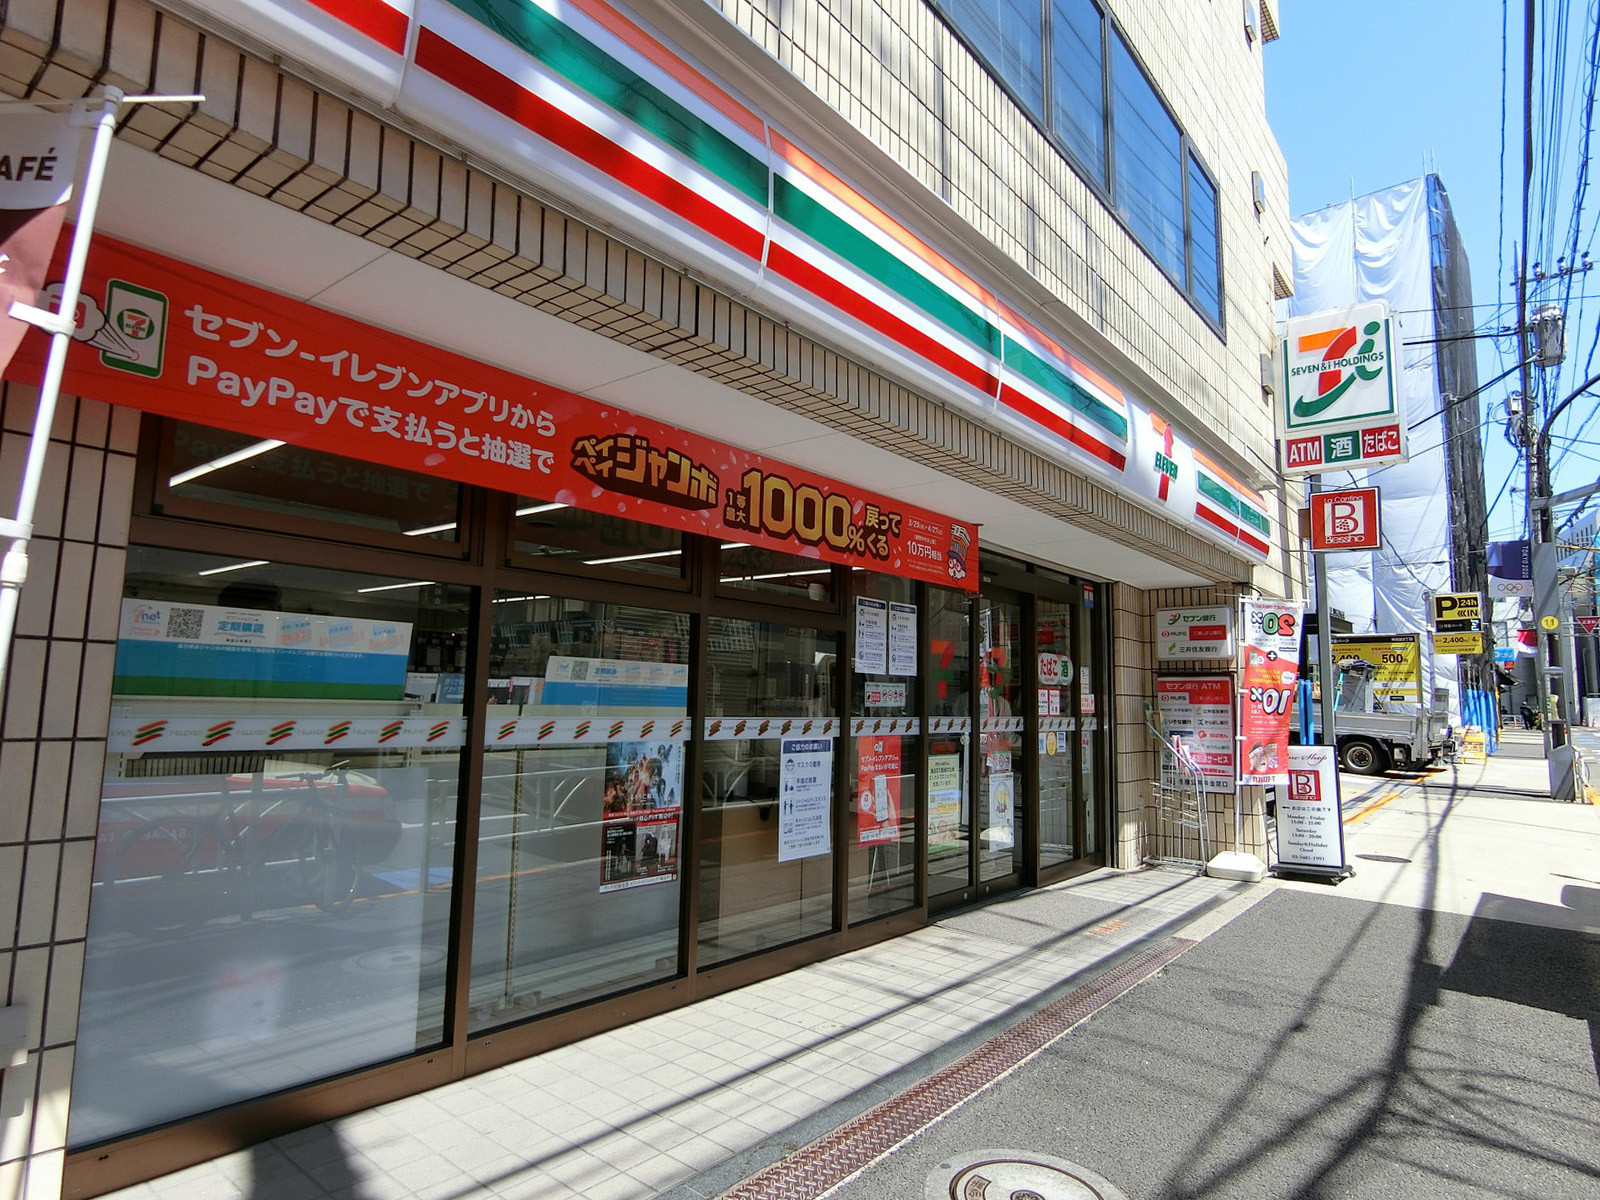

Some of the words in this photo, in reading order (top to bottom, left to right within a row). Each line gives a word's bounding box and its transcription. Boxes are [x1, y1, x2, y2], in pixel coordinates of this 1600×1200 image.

[184, 304, 556, 437] セブン-イレブンアプリから
[1291, 364, 1320, 376] SEVEN
[1333, 351, 1385, 368] HOLDINGS
[187, 355, 555, 474] PayPayで支払うと抽選で
[1289, 441, 1320, 463] ATM
[1330, 436, 1353, 459] 酒
[1363, 430, 1399, 454] たばこ
[865, 504, 901, 534] 戻って
[867, 533, 889, 556] くる
